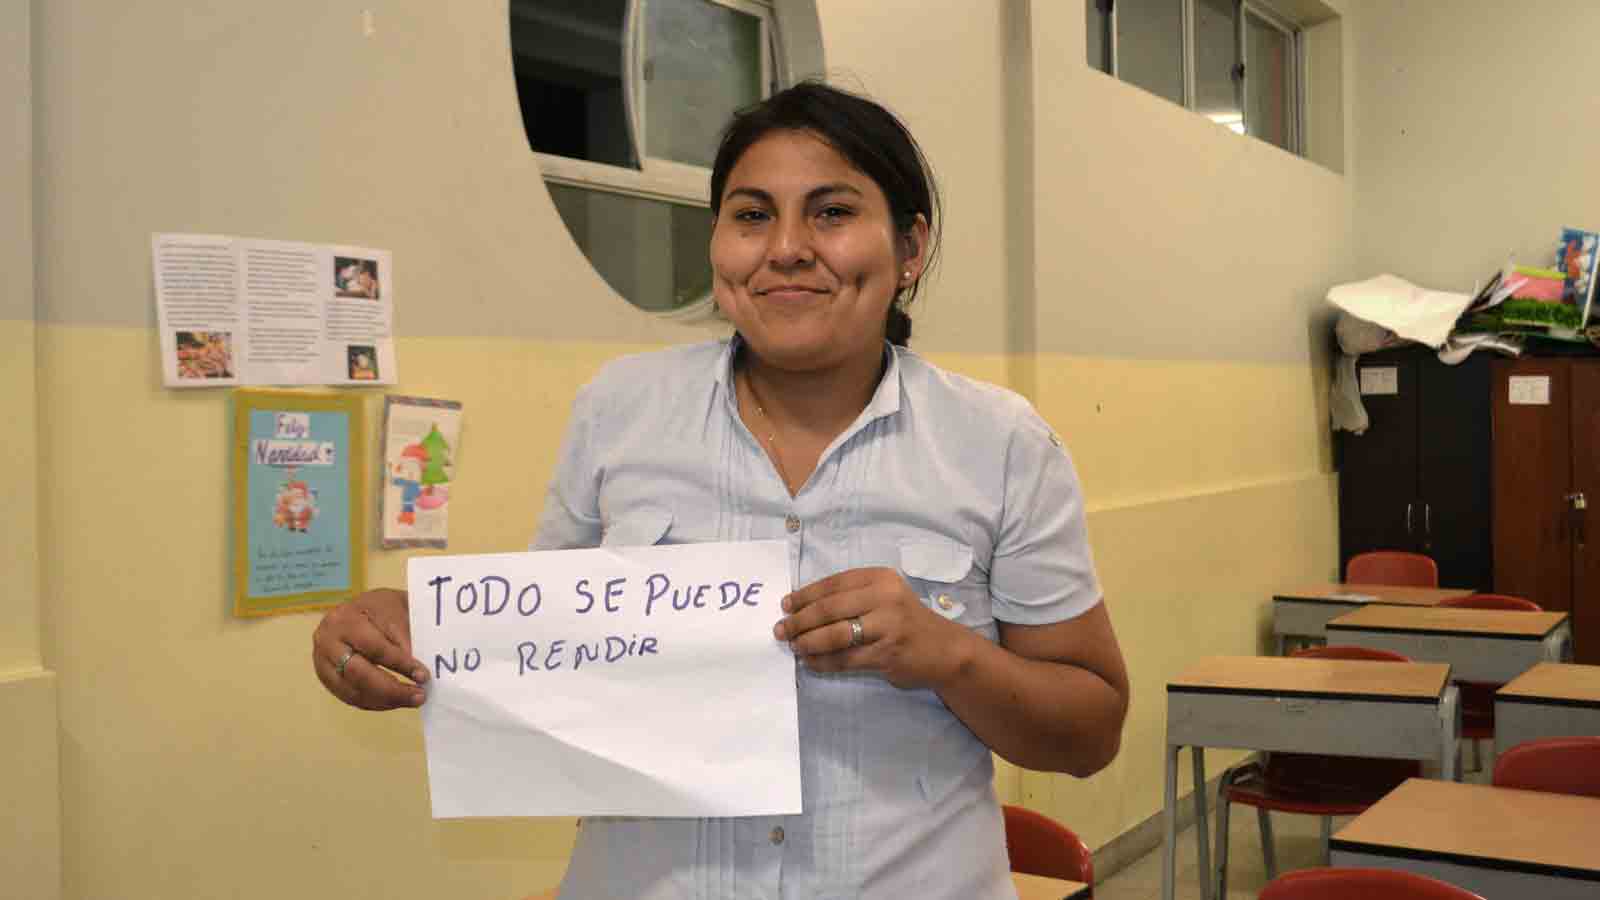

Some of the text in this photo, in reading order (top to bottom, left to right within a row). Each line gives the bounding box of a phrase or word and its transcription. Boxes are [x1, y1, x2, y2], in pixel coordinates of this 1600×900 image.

[428, 573, 764, 626] TODO SE PUEDE
[434, 647, 481, 679] NO
